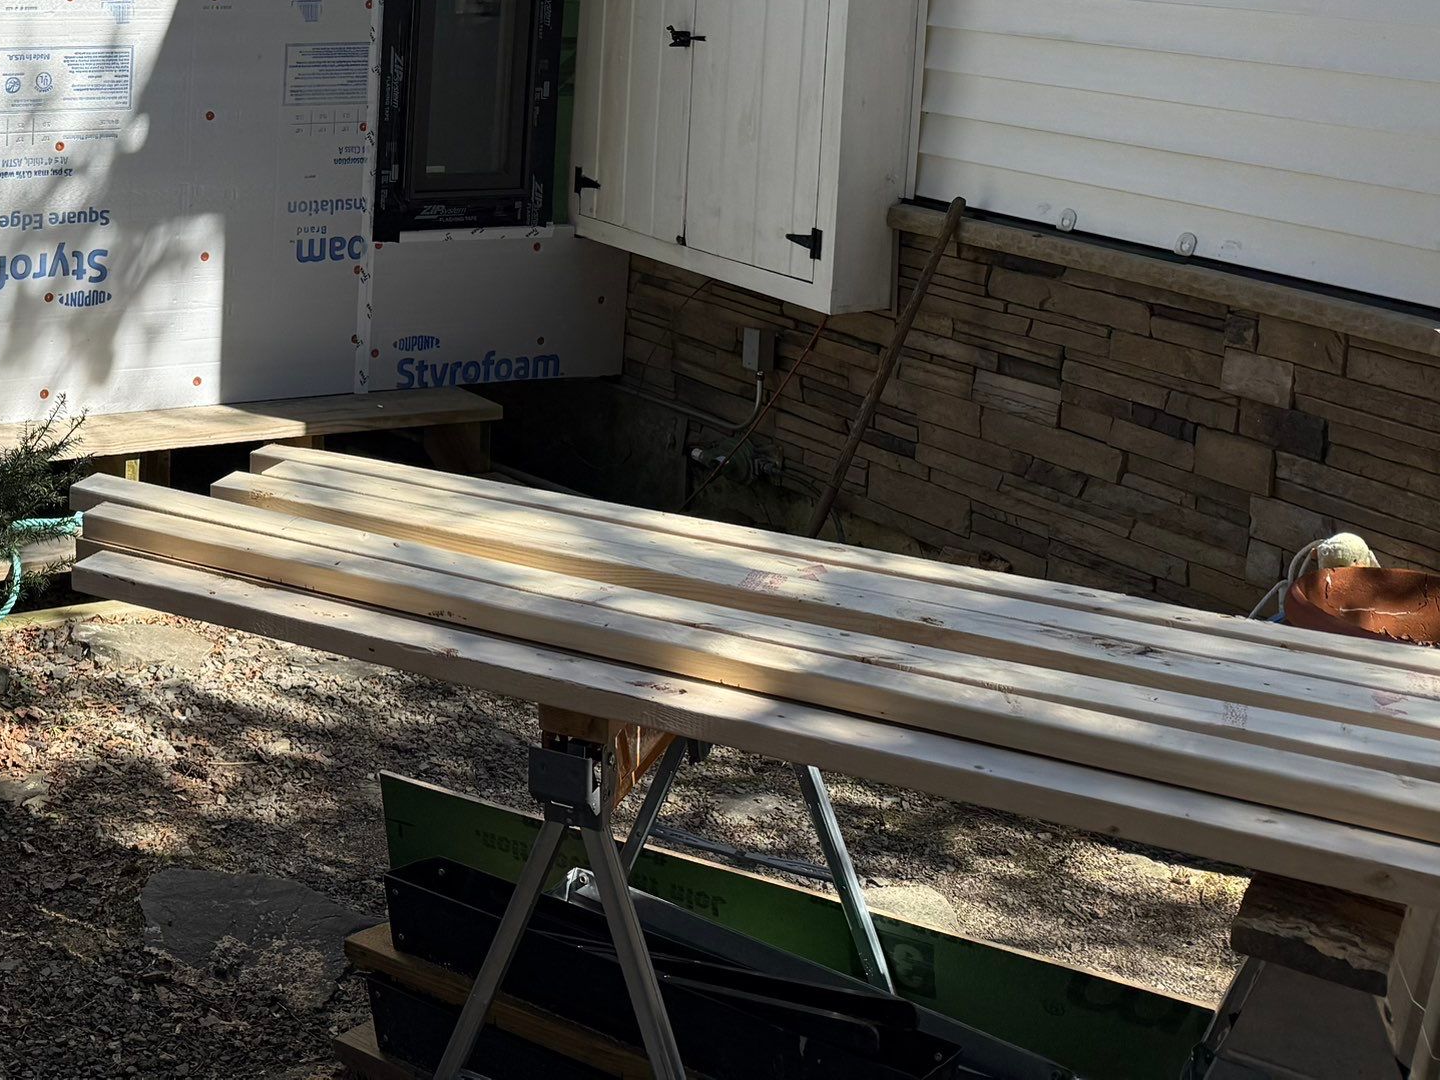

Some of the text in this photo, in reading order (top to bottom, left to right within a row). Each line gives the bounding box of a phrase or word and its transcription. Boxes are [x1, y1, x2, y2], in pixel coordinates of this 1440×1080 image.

[1, 158, 22, 167] ASTM
[23, 157, 43, 166] thick,
[63, 168, 73, 176] 25
[0, 211, 43, 230] Edge
[49, 207, 110, 225] Square
[296, 225, 327, 235] Brand
[62, 291, 109, 308] DUPONT
[395, 334, 440, 352] DUPONT
[397, 350, 560, 389] Styrofoam
